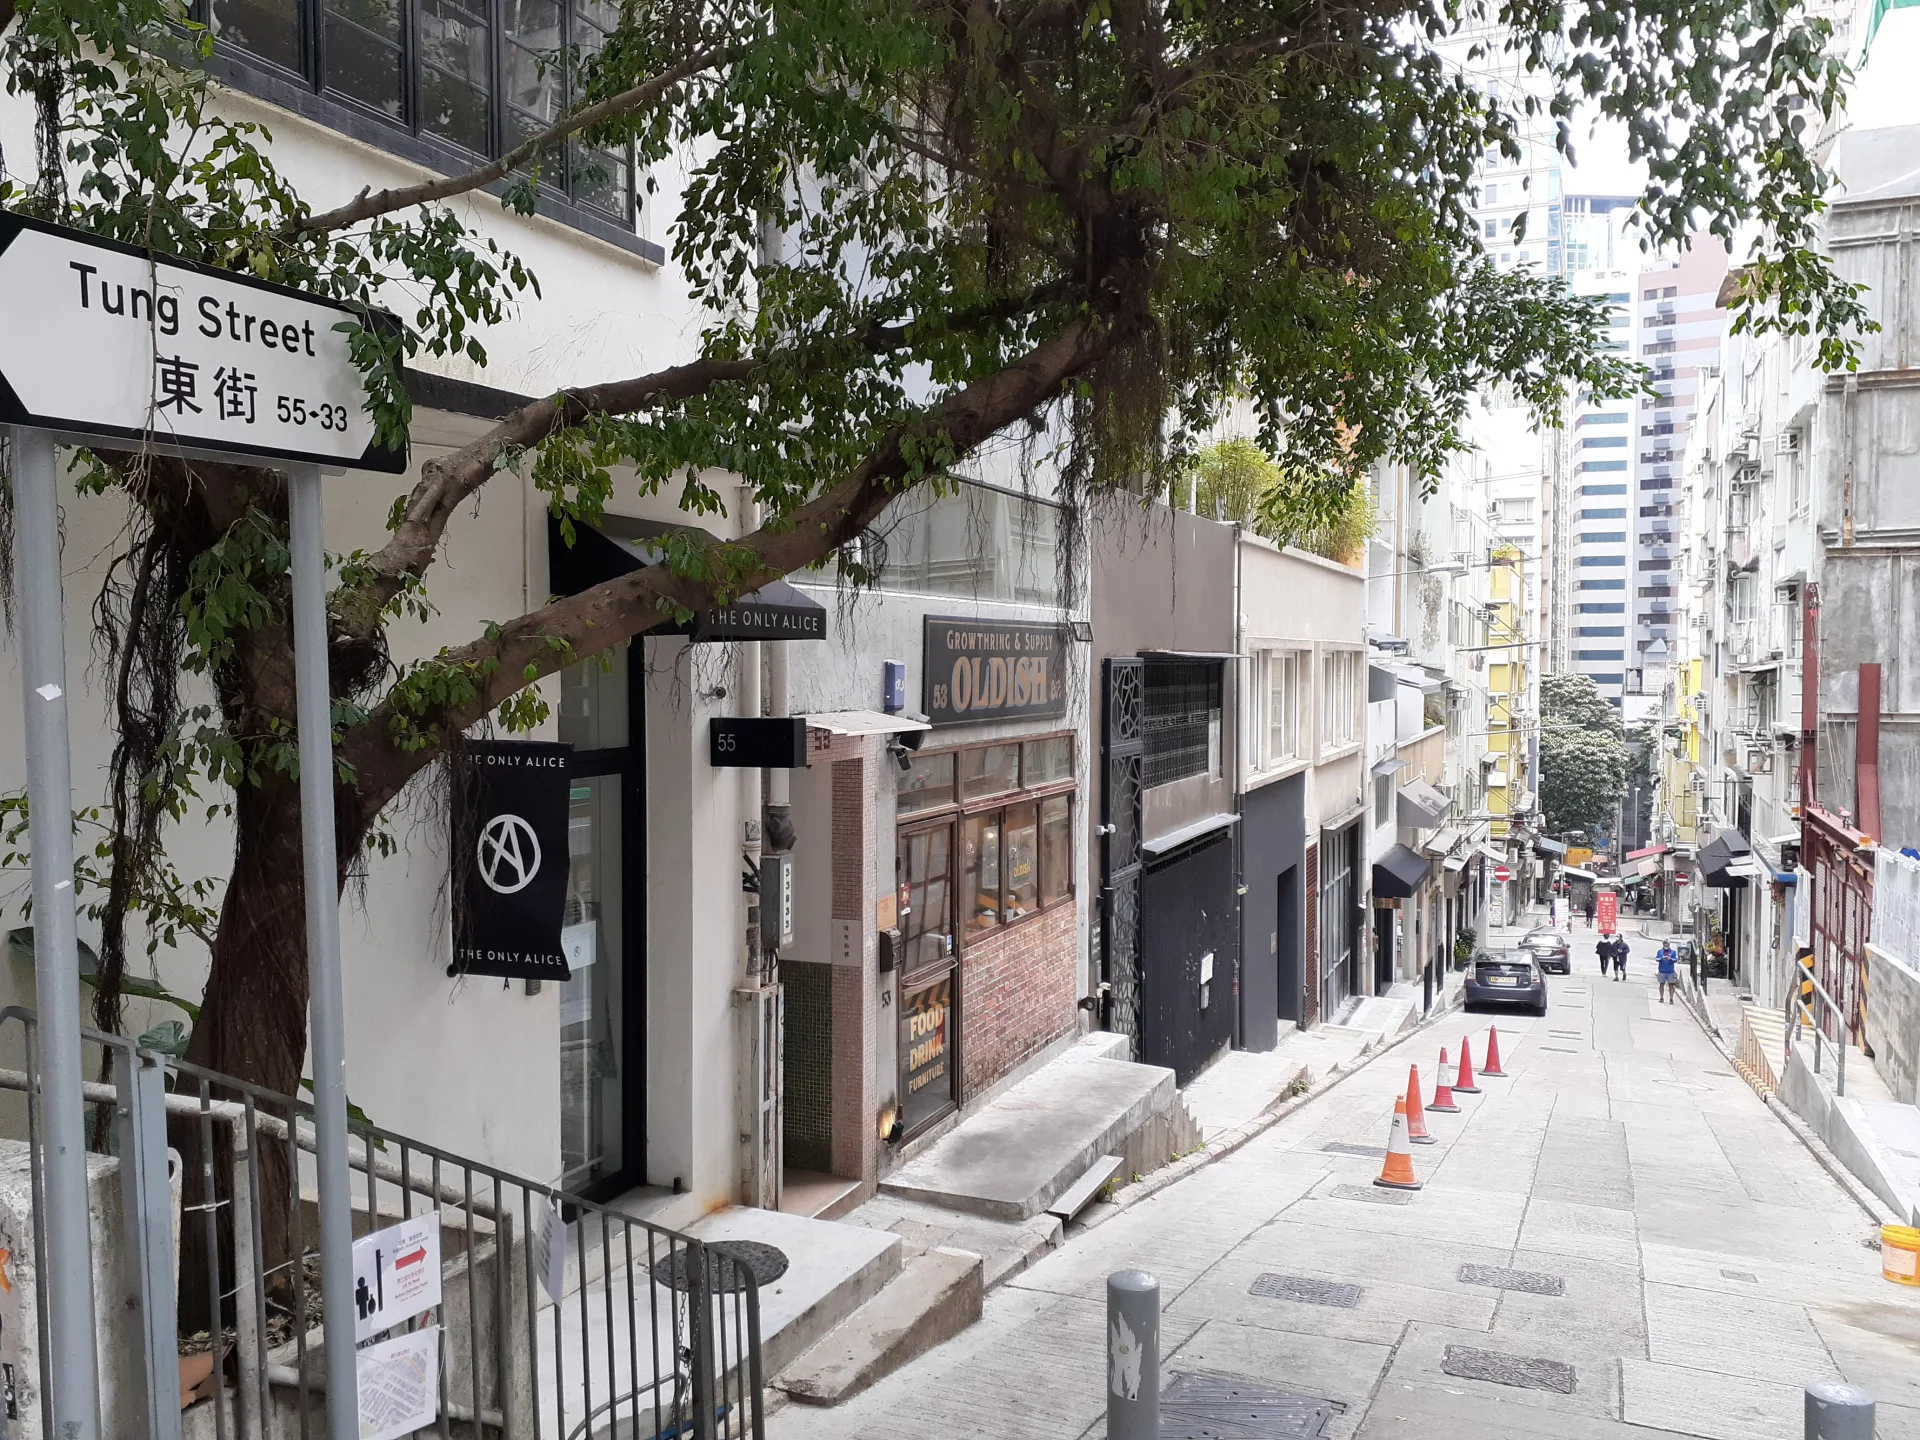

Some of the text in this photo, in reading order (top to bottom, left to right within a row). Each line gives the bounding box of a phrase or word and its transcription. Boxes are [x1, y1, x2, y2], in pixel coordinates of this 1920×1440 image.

[69, 261, 316, 357] Tung Street
[156, 354, 258, 424] 東街
[743, 611, 778, 628] ONLY
[783, 615, 818, 632] ALICE
[1014, 632, 1021, 650] &
[933, 684, 948, 709] 53
[951, 656, 1049, 713] OLDISH
[718, 733, 736, 751] 55
[487, 755, 521, 766] ONLY
[526, 756, 565, 768] ALICE
[460, 948, 562, 966] THE ONLY ALICE
[881, 990, 892, 1008] 53
[910, 1003, 944, 1042] FOOD
[909, 1033, 944, 1072] DRINK
[908, 1061, 945, 1095] FURNITURE
